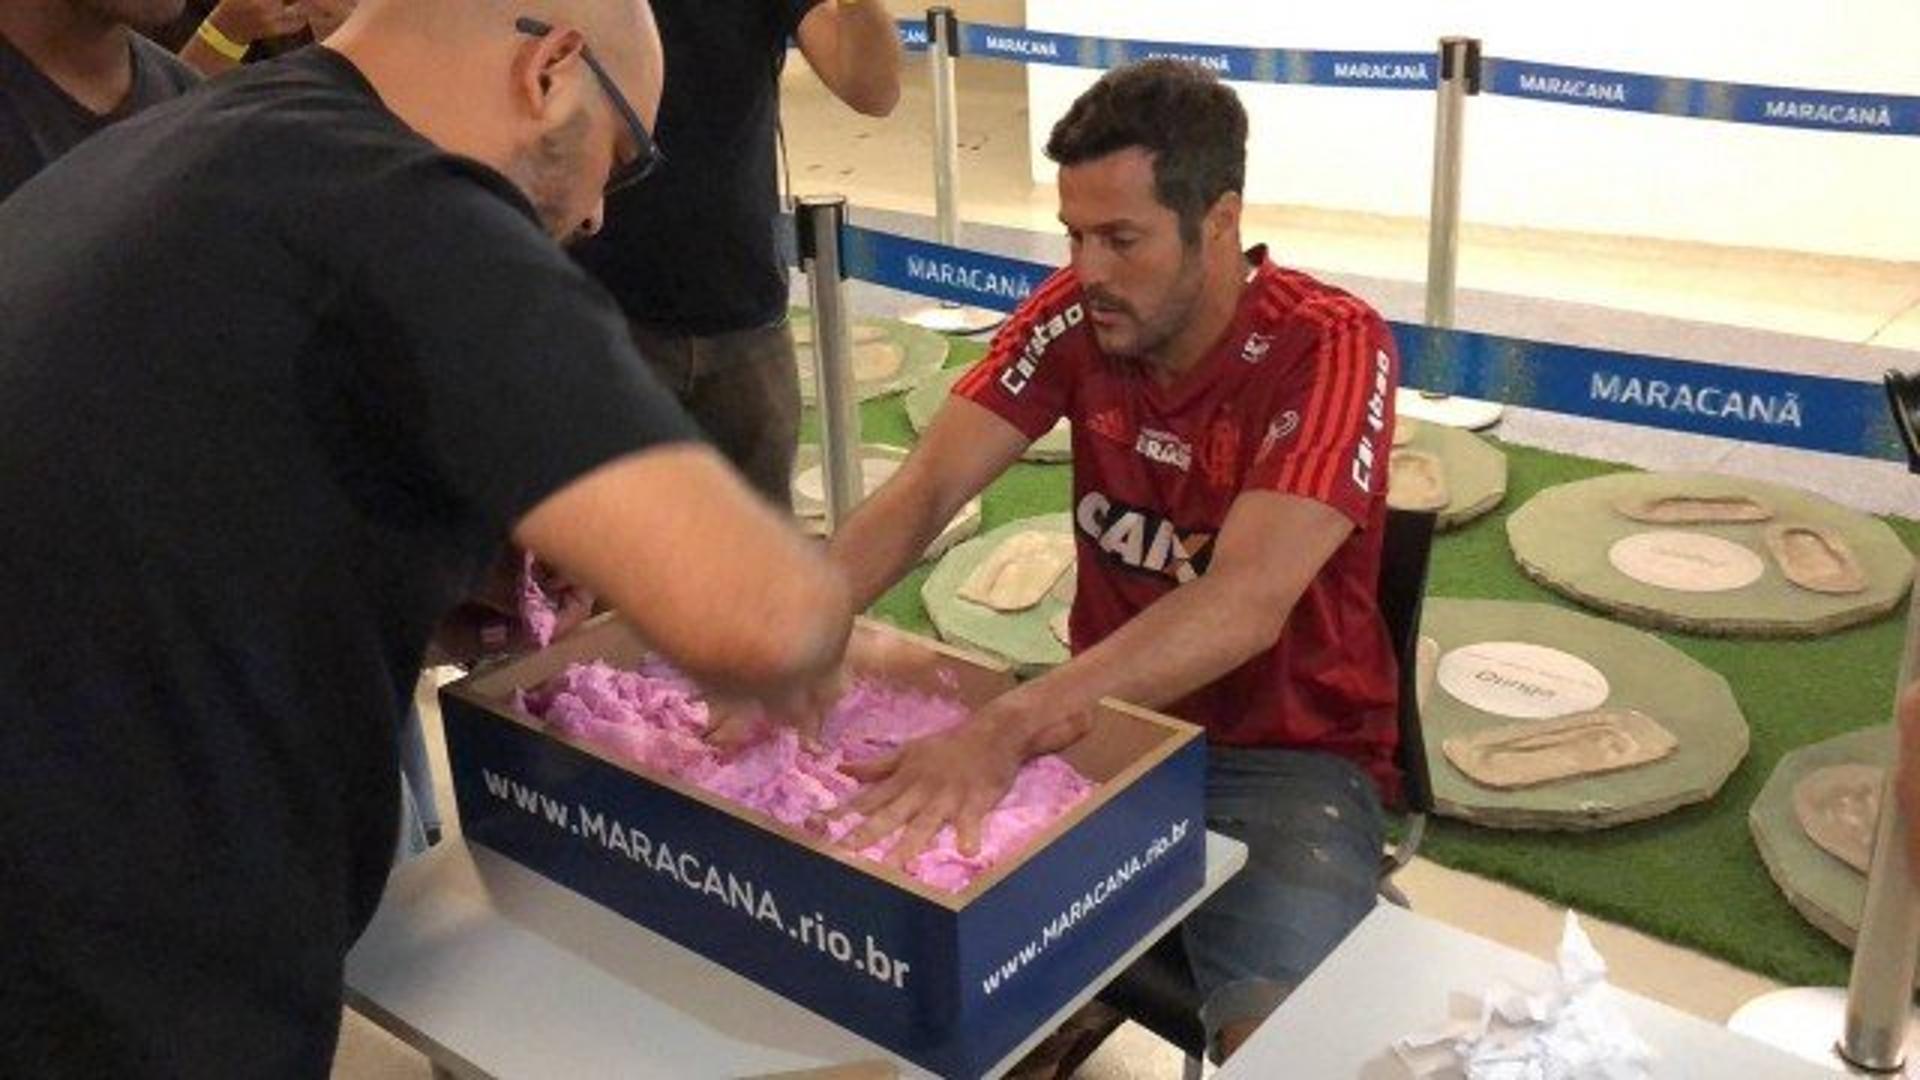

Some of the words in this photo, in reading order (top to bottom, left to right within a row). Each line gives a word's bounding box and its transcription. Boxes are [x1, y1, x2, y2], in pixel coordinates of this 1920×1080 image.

[1334, 62, 1429, 81] MARACANÃ
[1519, 74, 1626, 102] MARACANÃ
[1764, 100, 1892, 127] MARACANÃ
[1590, 371, 1802, 428] MARACANÃ
[1076, 491, 1212, 583] CAIX
[483, 767, 910, 989] www.MARACANA.rio.br
[983, 818, 1189, 994] www.MARACANA.rio.br
